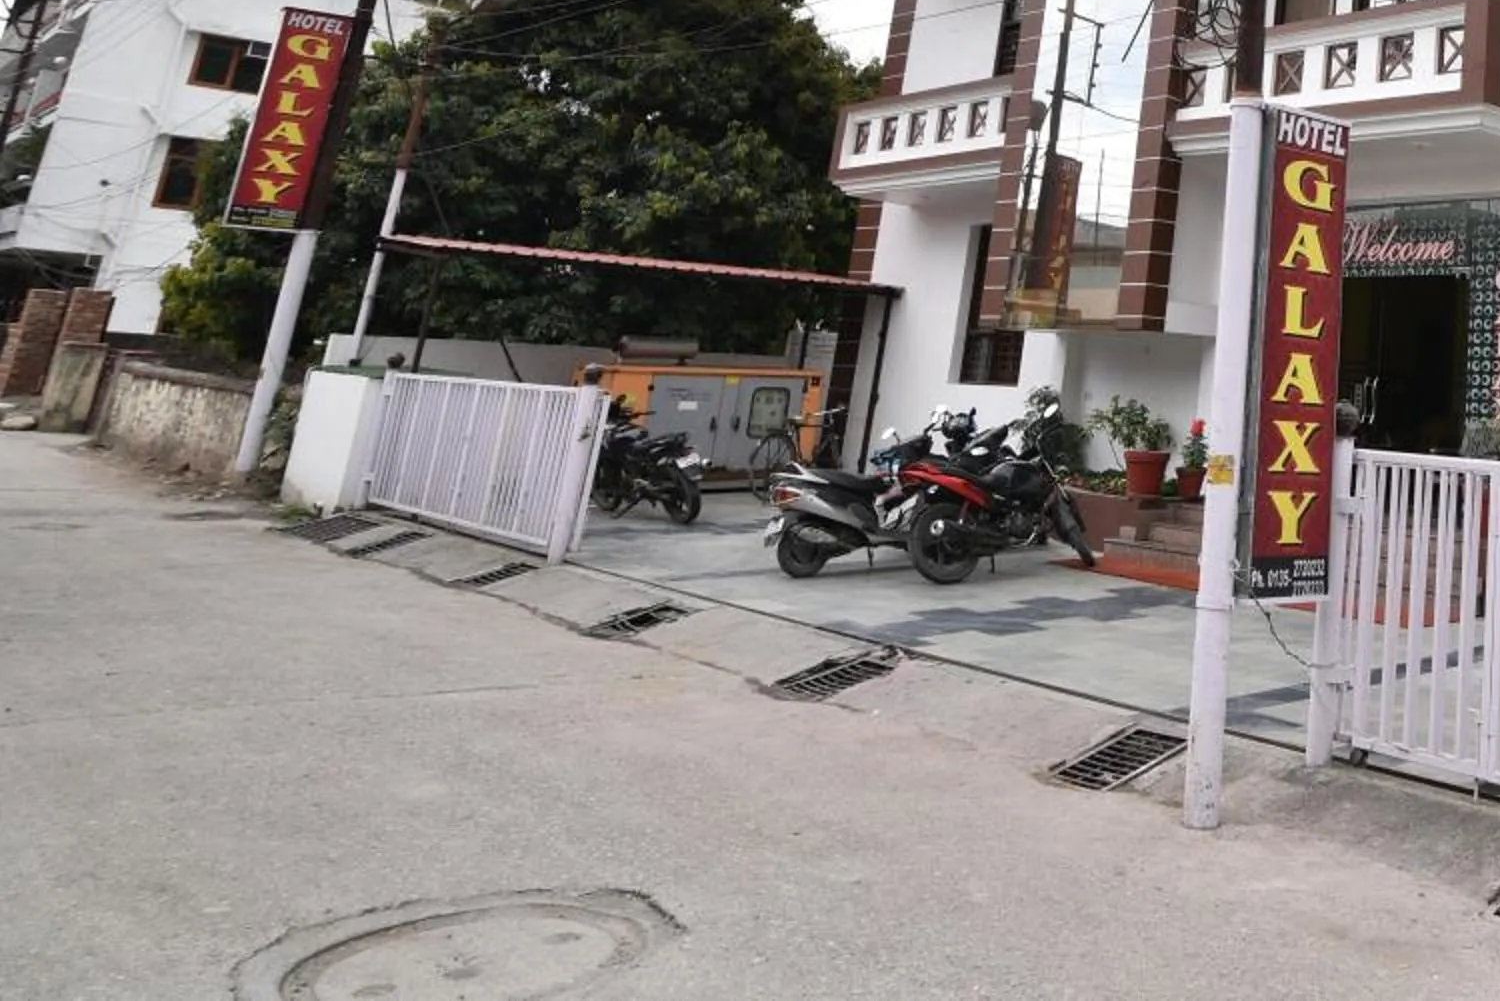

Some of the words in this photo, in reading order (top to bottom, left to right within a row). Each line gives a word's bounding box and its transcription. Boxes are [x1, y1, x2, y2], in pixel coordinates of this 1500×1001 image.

[288, 12, 344, 35] HOTEL
[253, 34, 333, 205] GALAXY
[1278, 111, 1347, 157] HOTEL
[1344, 220, 1455, 264] Welcome
[1267, 159, 1336, 545] GALAXY
